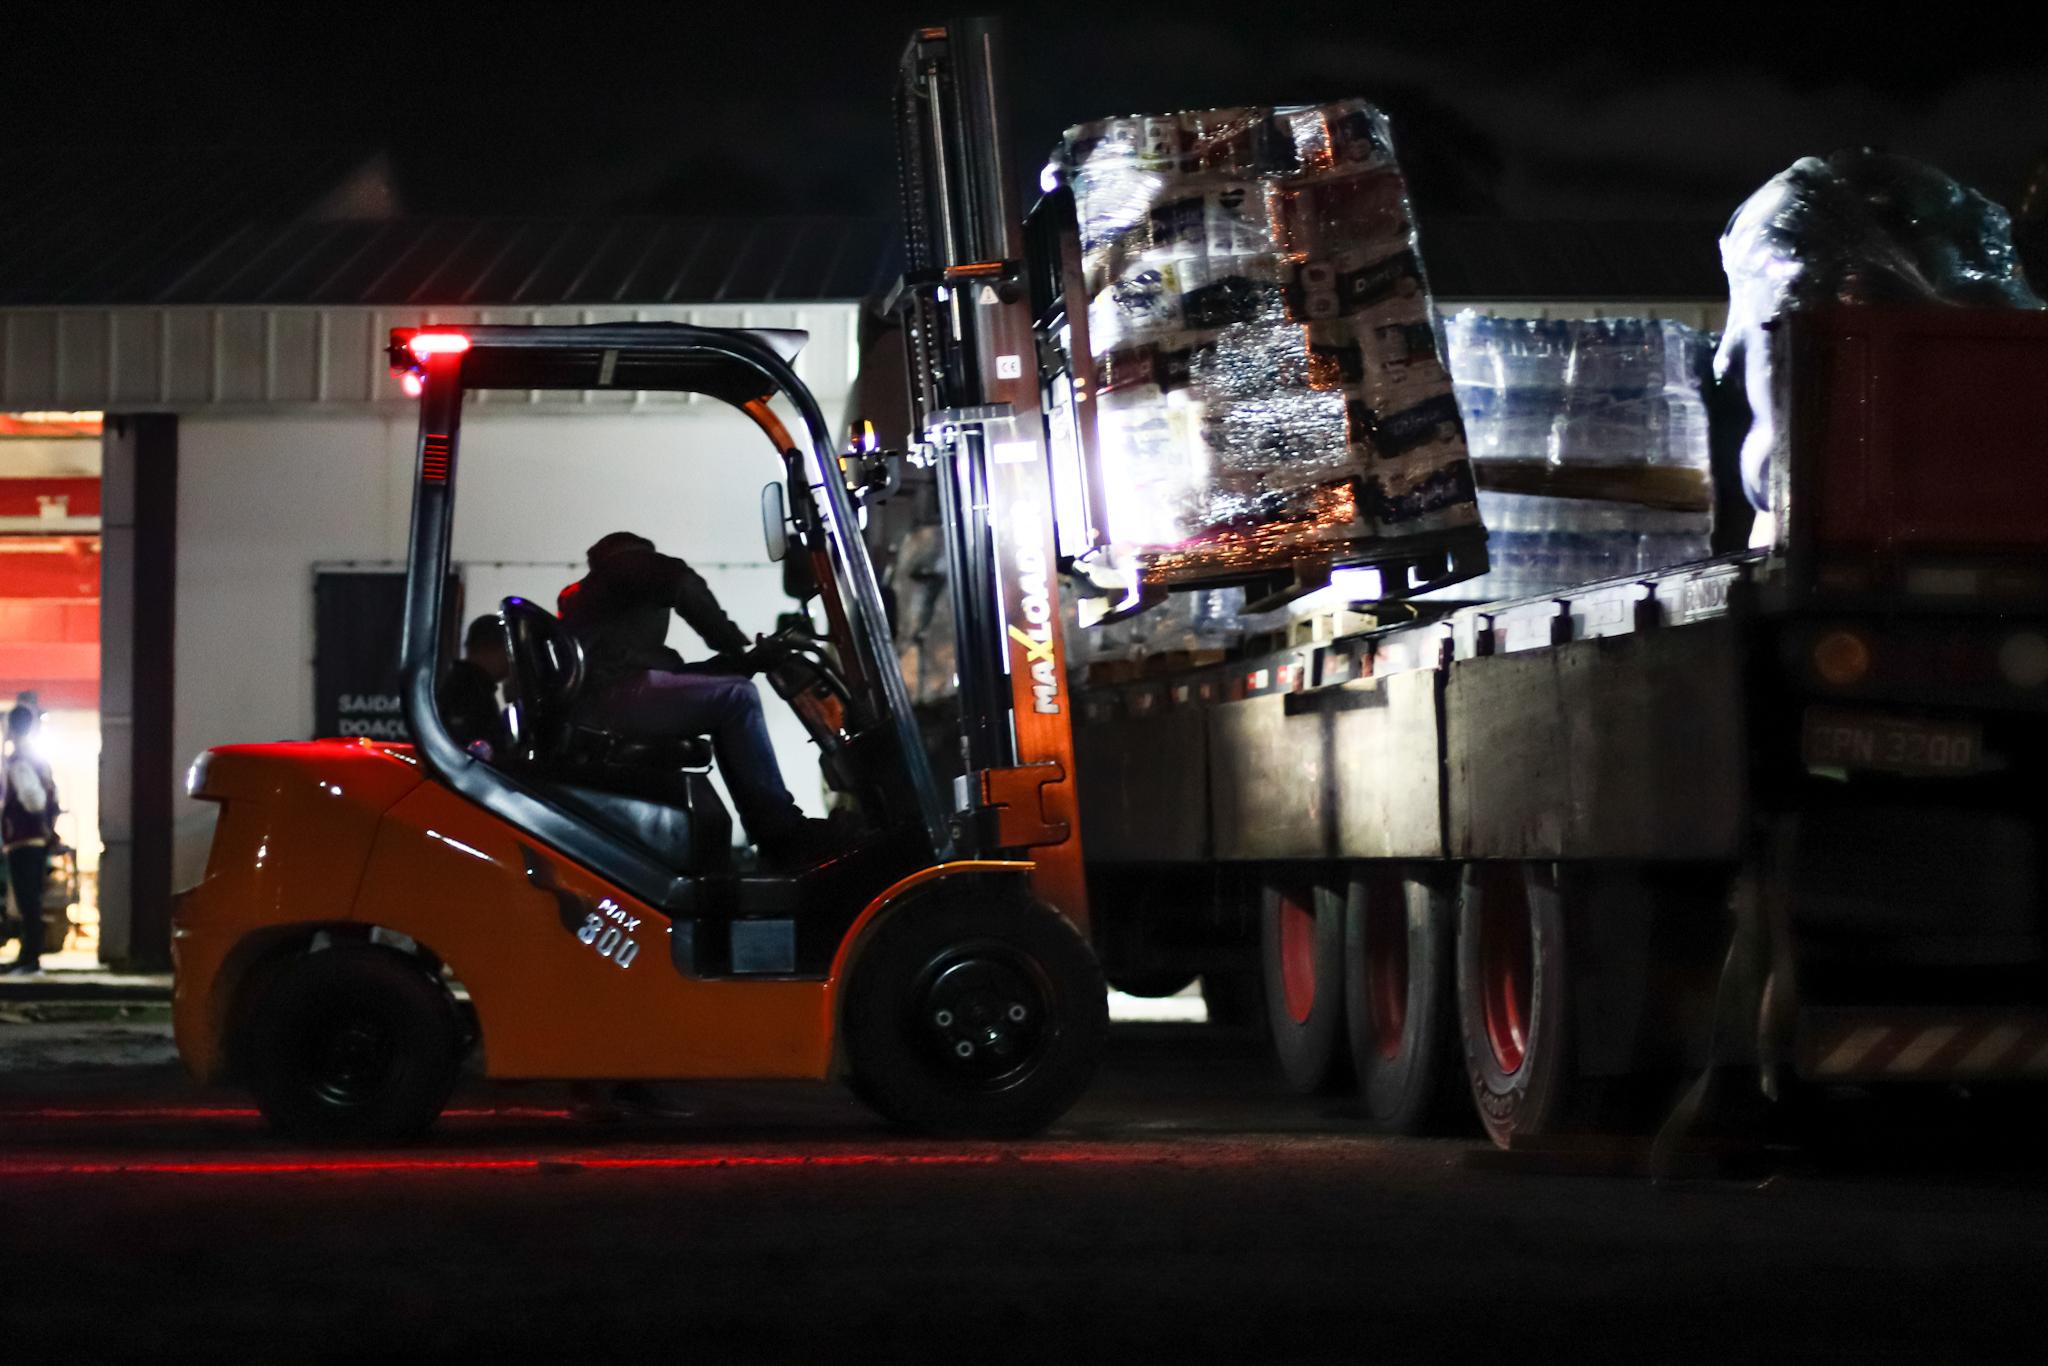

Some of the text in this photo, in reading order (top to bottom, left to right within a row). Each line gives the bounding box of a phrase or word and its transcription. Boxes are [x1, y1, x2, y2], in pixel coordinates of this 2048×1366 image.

[1008, 500, 1060, 714] MAXLOAD
[576, 912, 641, 969] 800
[598, 898, 641, 932] MAX
